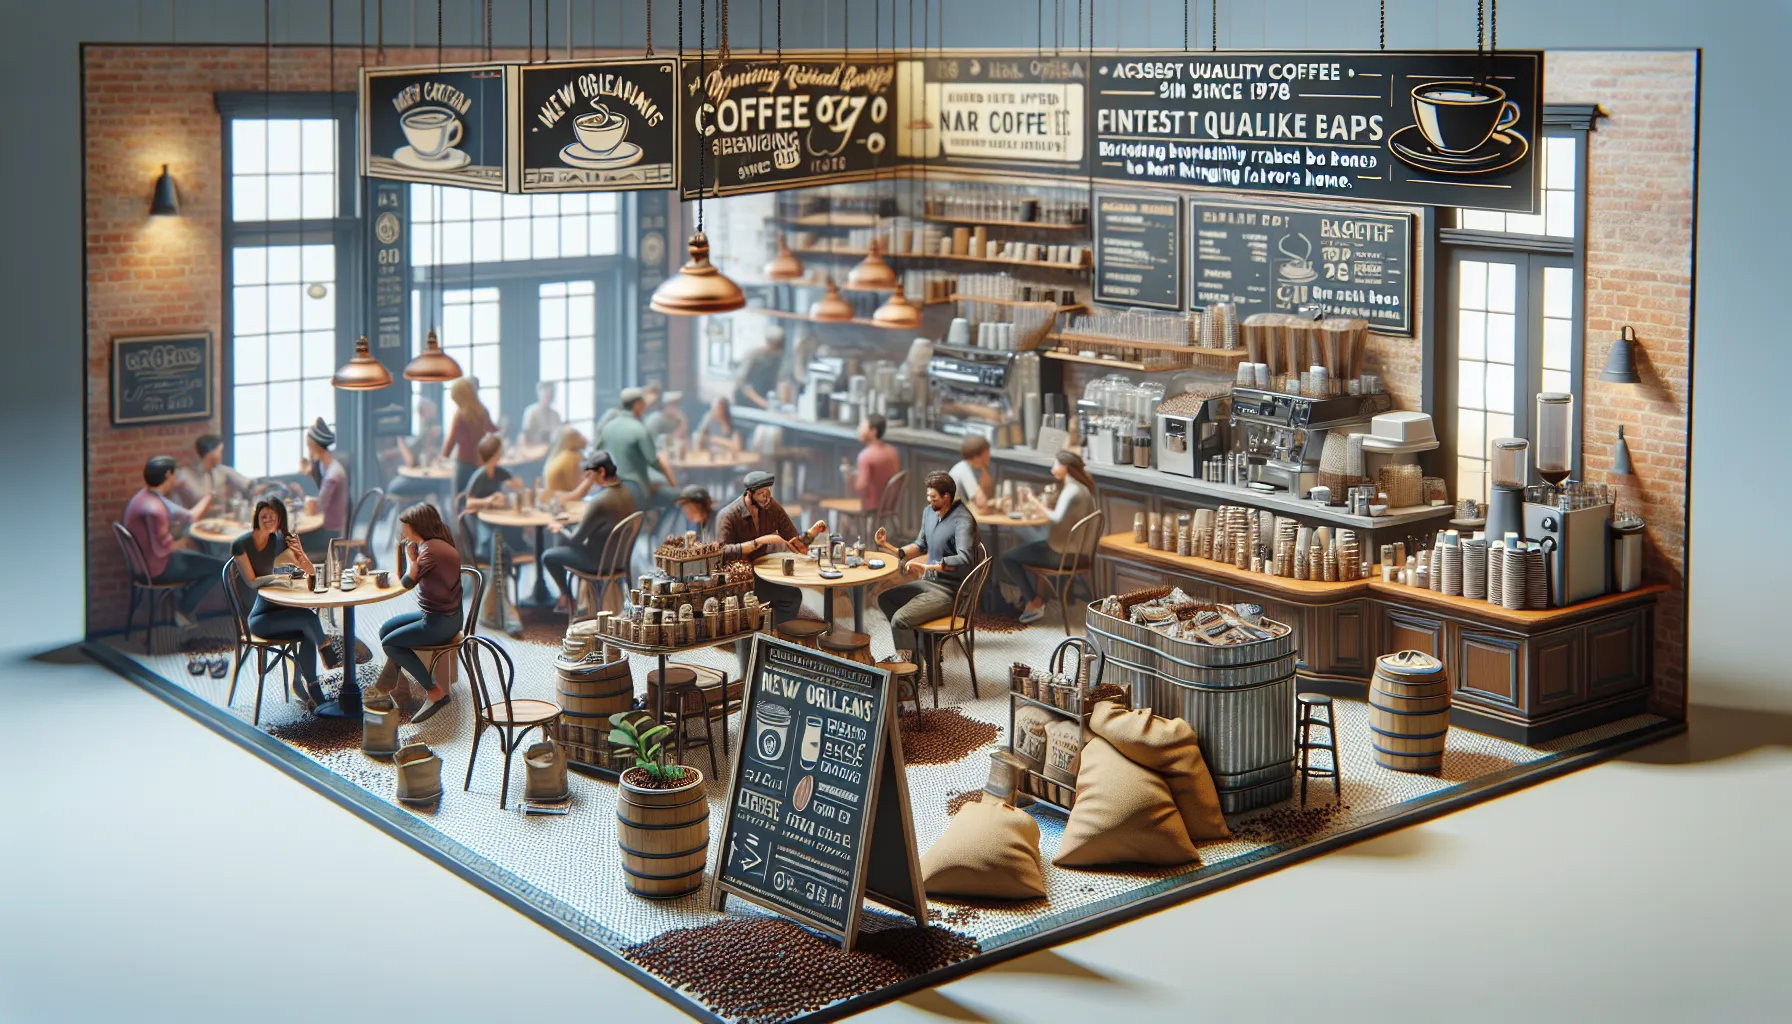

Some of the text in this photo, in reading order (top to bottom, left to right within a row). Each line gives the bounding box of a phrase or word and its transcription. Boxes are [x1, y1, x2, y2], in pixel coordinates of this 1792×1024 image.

[1268, 63, 1341, 81] COFFEE
[1191, 83, 1243, 100] SINCE
[1204, 110, 1307, 139] QUALIKE
[761, 671, 801, 699] NEW
